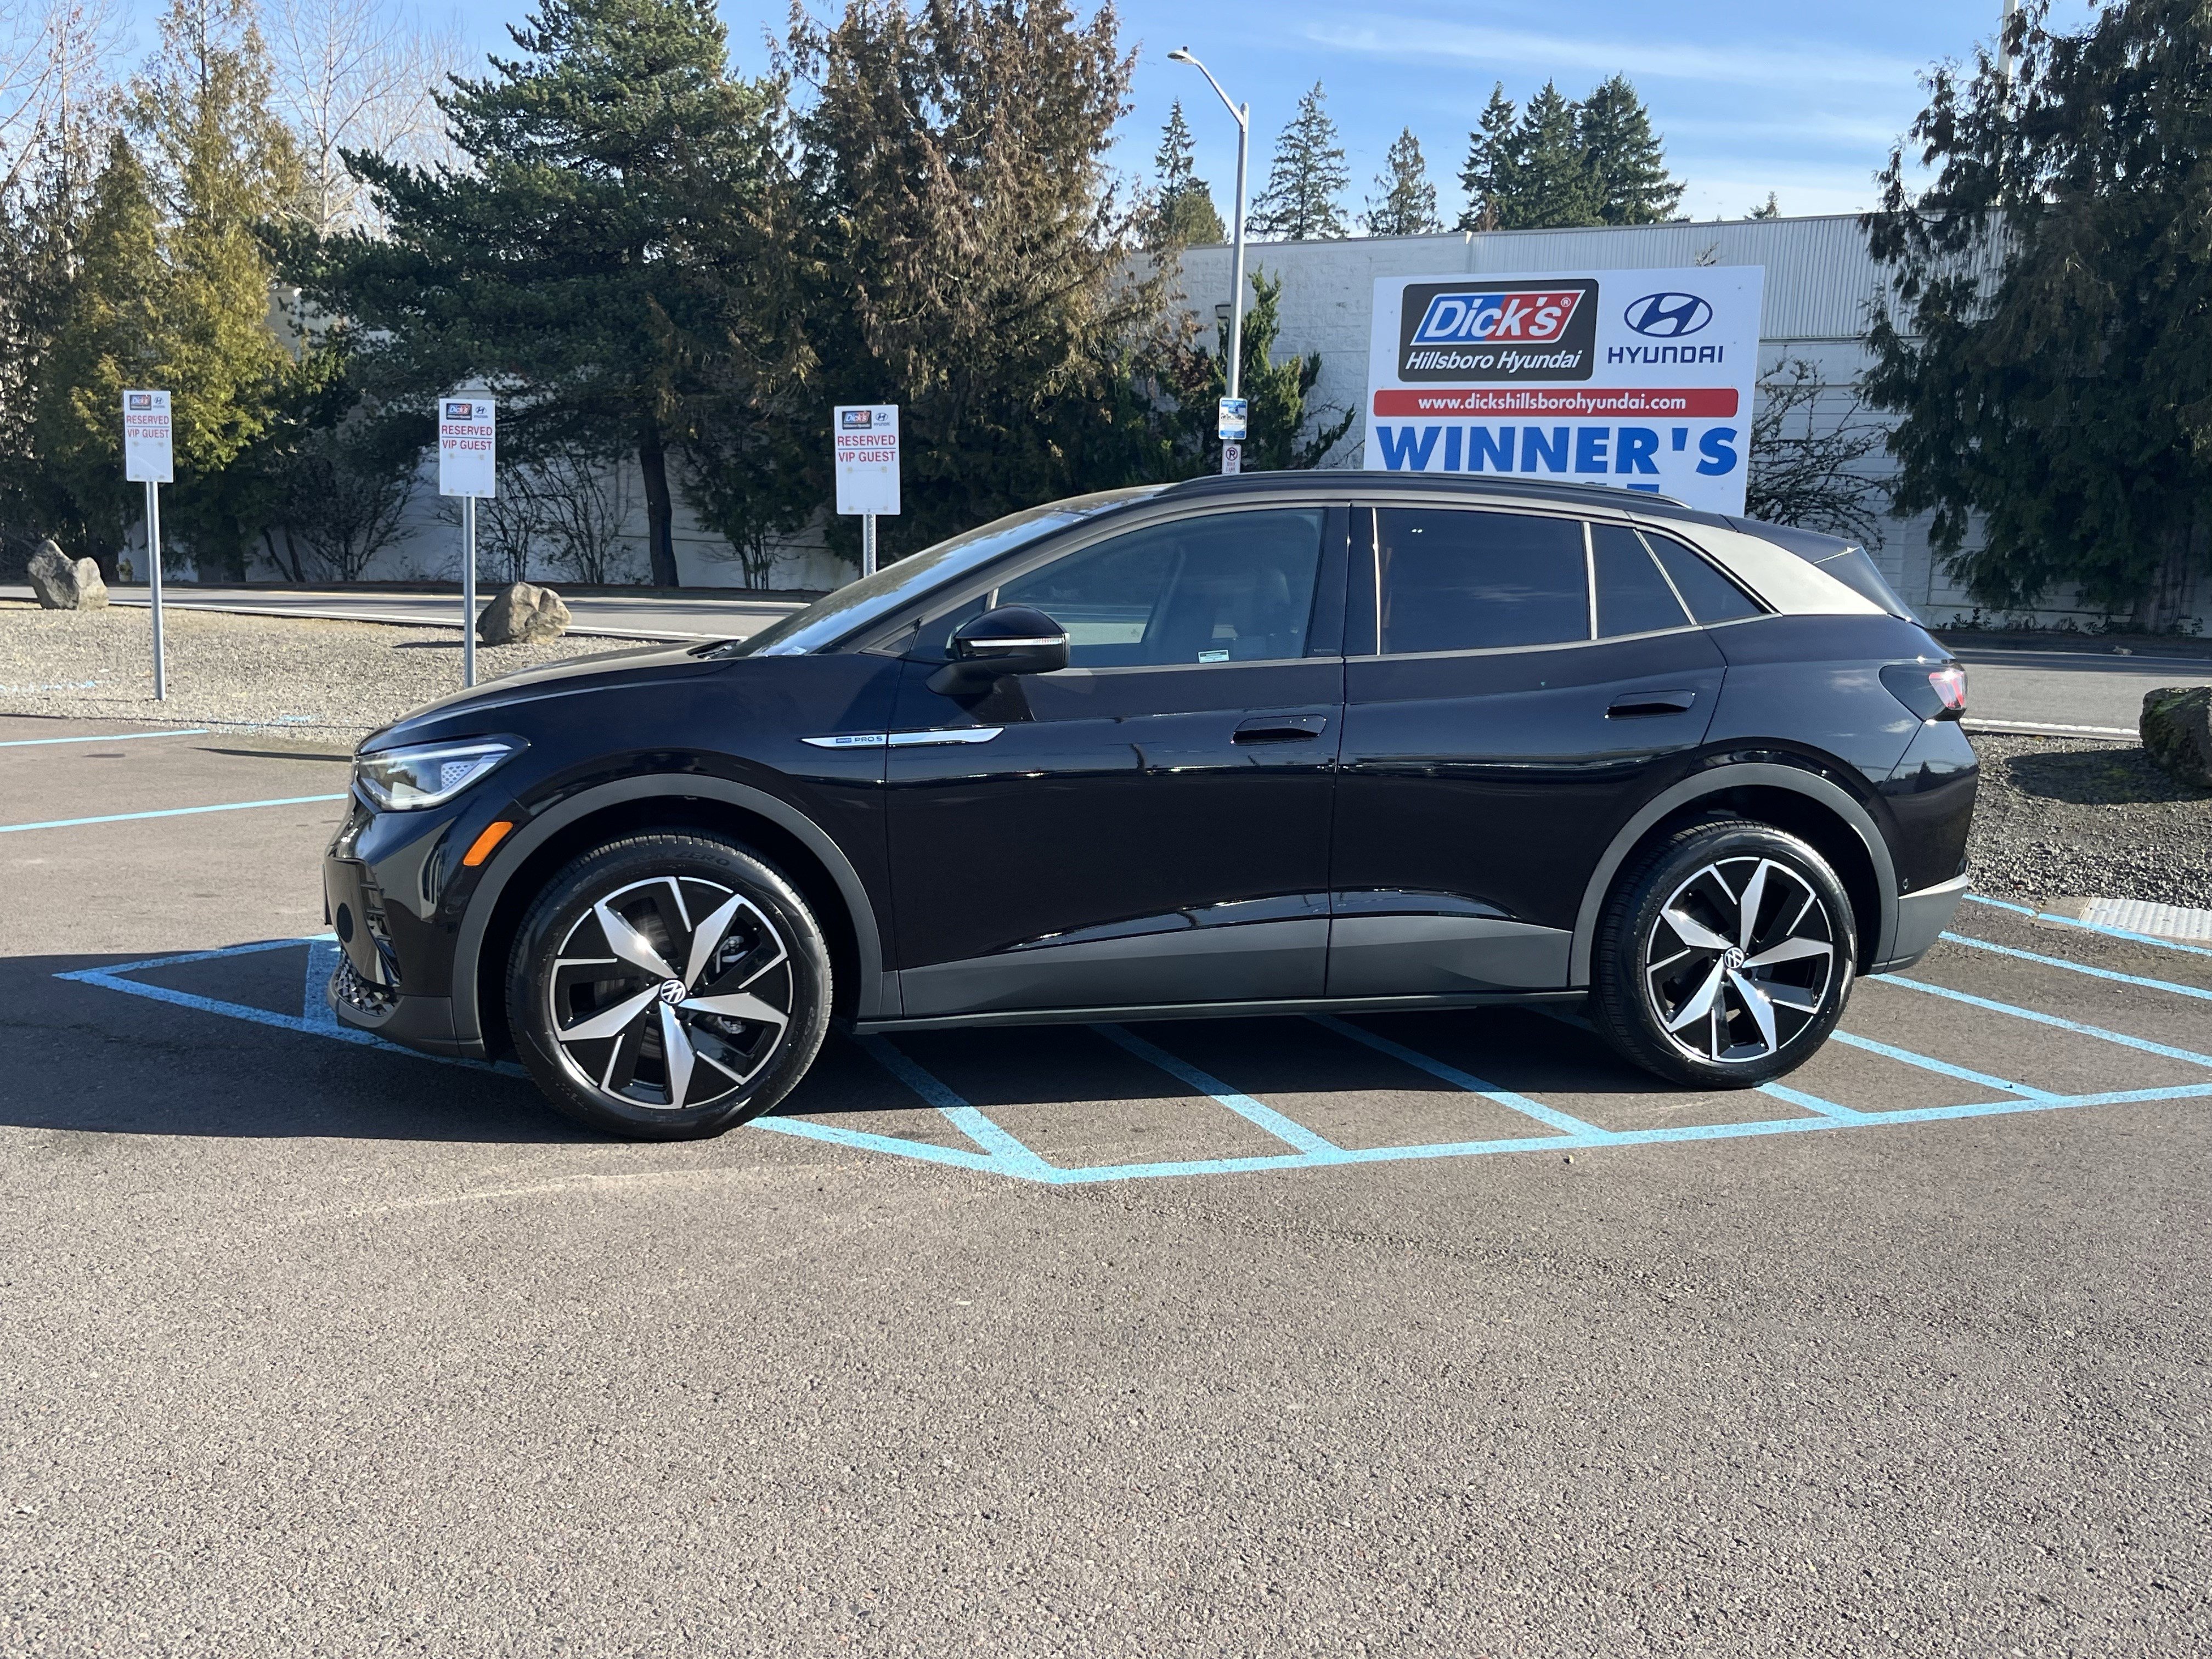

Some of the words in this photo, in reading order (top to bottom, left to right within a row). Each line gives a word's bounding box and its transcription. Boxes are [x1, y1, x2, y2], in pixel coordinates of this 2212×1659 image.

[1607, 345, 1723, 364] HYUNDAI
[1405, 351, 1494, 370] Hillsboro
[1497, 349, 1583, 374] Hyundai
[1418, 392, 1686, 414] www.dickshillsborohyundai.com
[126, 415, 170, 425] RESERVED
[127, 429, 140, 438] VIP
[142, 428, 170, 438] GUEST
[442, 425, 493, 436] RESERVED
[442, 439, 457, 449] VIP
[460, 439, 493, 450] GUEST
[838, 435, 896, 447] RESERVED
[838, 452, 855, 462] VIP
[859, 451, 896, 462] GUEST
[1375, 426, 1739, 476] WINNER'S
